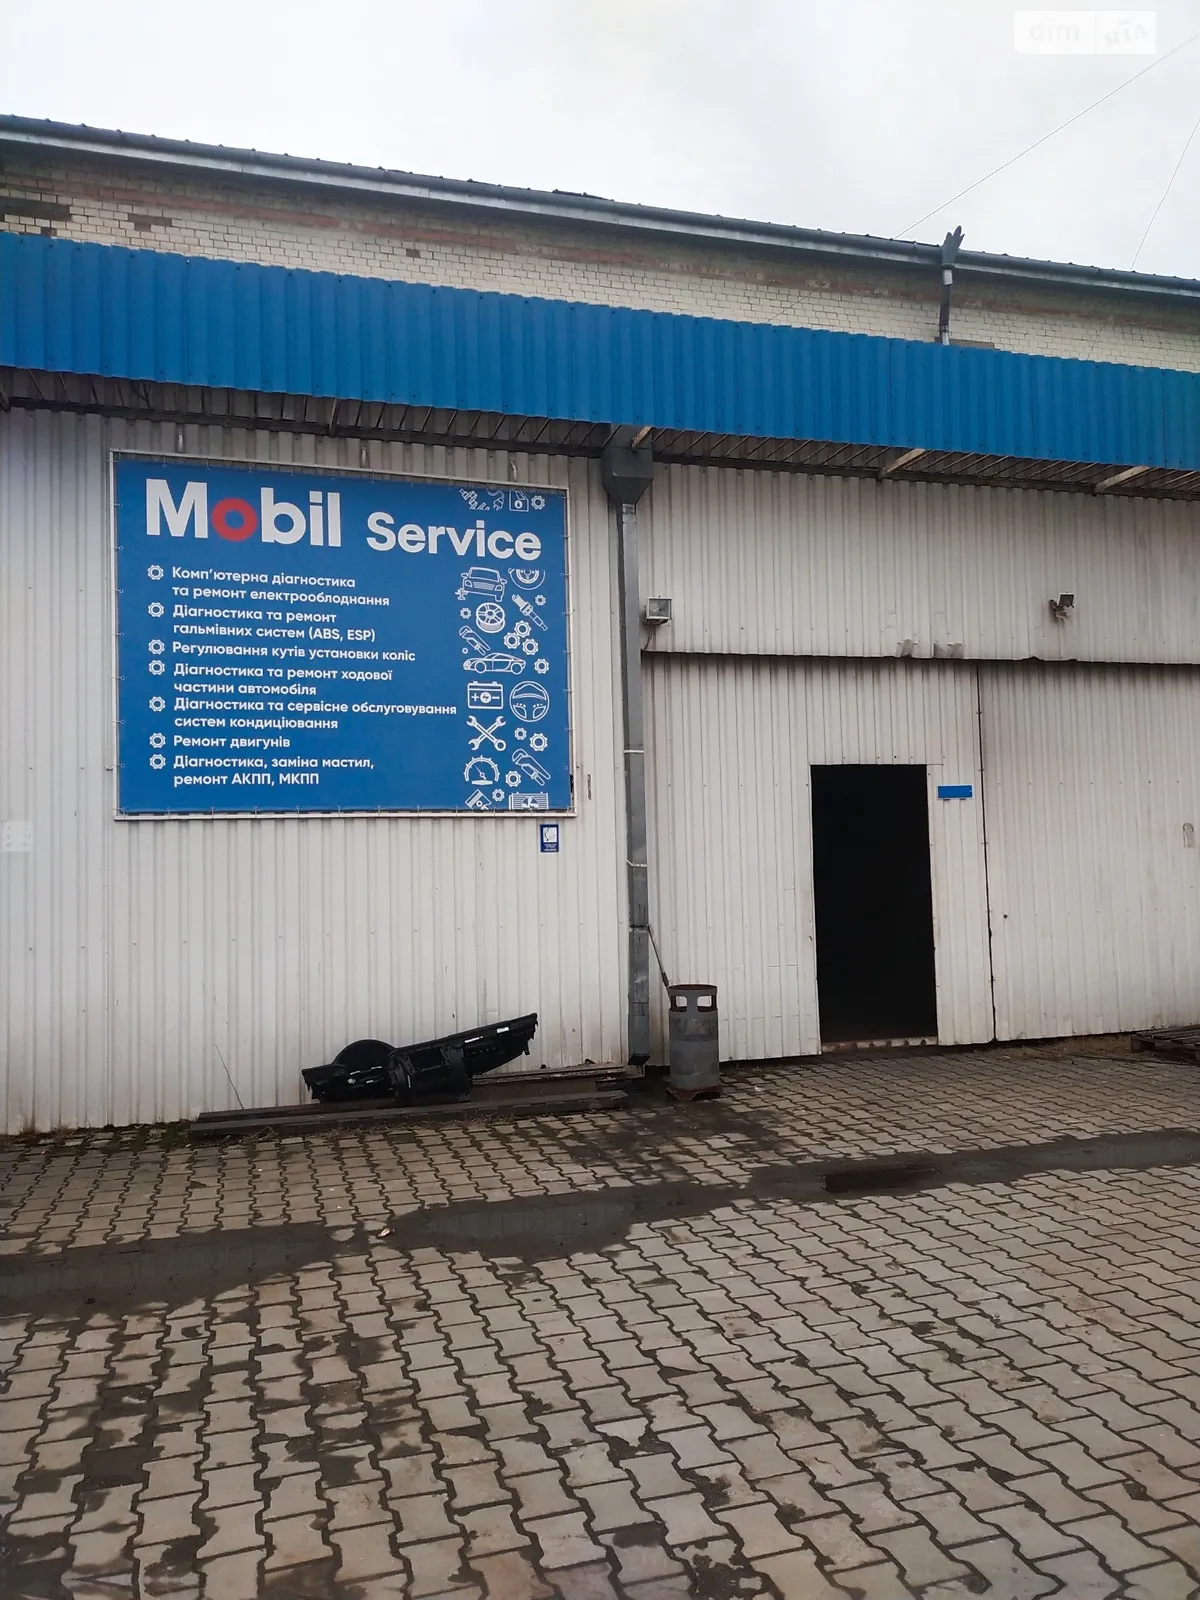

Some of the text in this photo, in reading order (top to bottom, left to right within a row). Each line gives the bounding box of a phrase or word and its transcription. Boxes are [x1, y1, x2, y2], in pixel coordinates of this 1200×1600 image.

[145, 478, 541, 561] Mobil Service
[272, 572, 355, 588] діагностика
[172, 587, 189, 597] та
[193, 588, 247, 600] ремонт
[173, 605, 337, 624] Діагностика та ремонт
[173, 624, 376, 642] гальмівних систем (ABS, ESP)
[172, 642, 416, 661] Регулювання кутів установки коліс
[173, 663, 393, 681] Діагностика та ремонт ходової
[174, 683, 317, 696] частини автомобіля
[174, 697, 457, 716] Діагностика та сервісне обслуговування
[174, 717, 338, 730] систем кондиціювання
[173, 735, 291, 750] Ремонт двигунів
[173, 756, 374, 769] Діагностика, заміна мастил,
[174, 773, 319, 787] ремонт АКПП, МКПП
